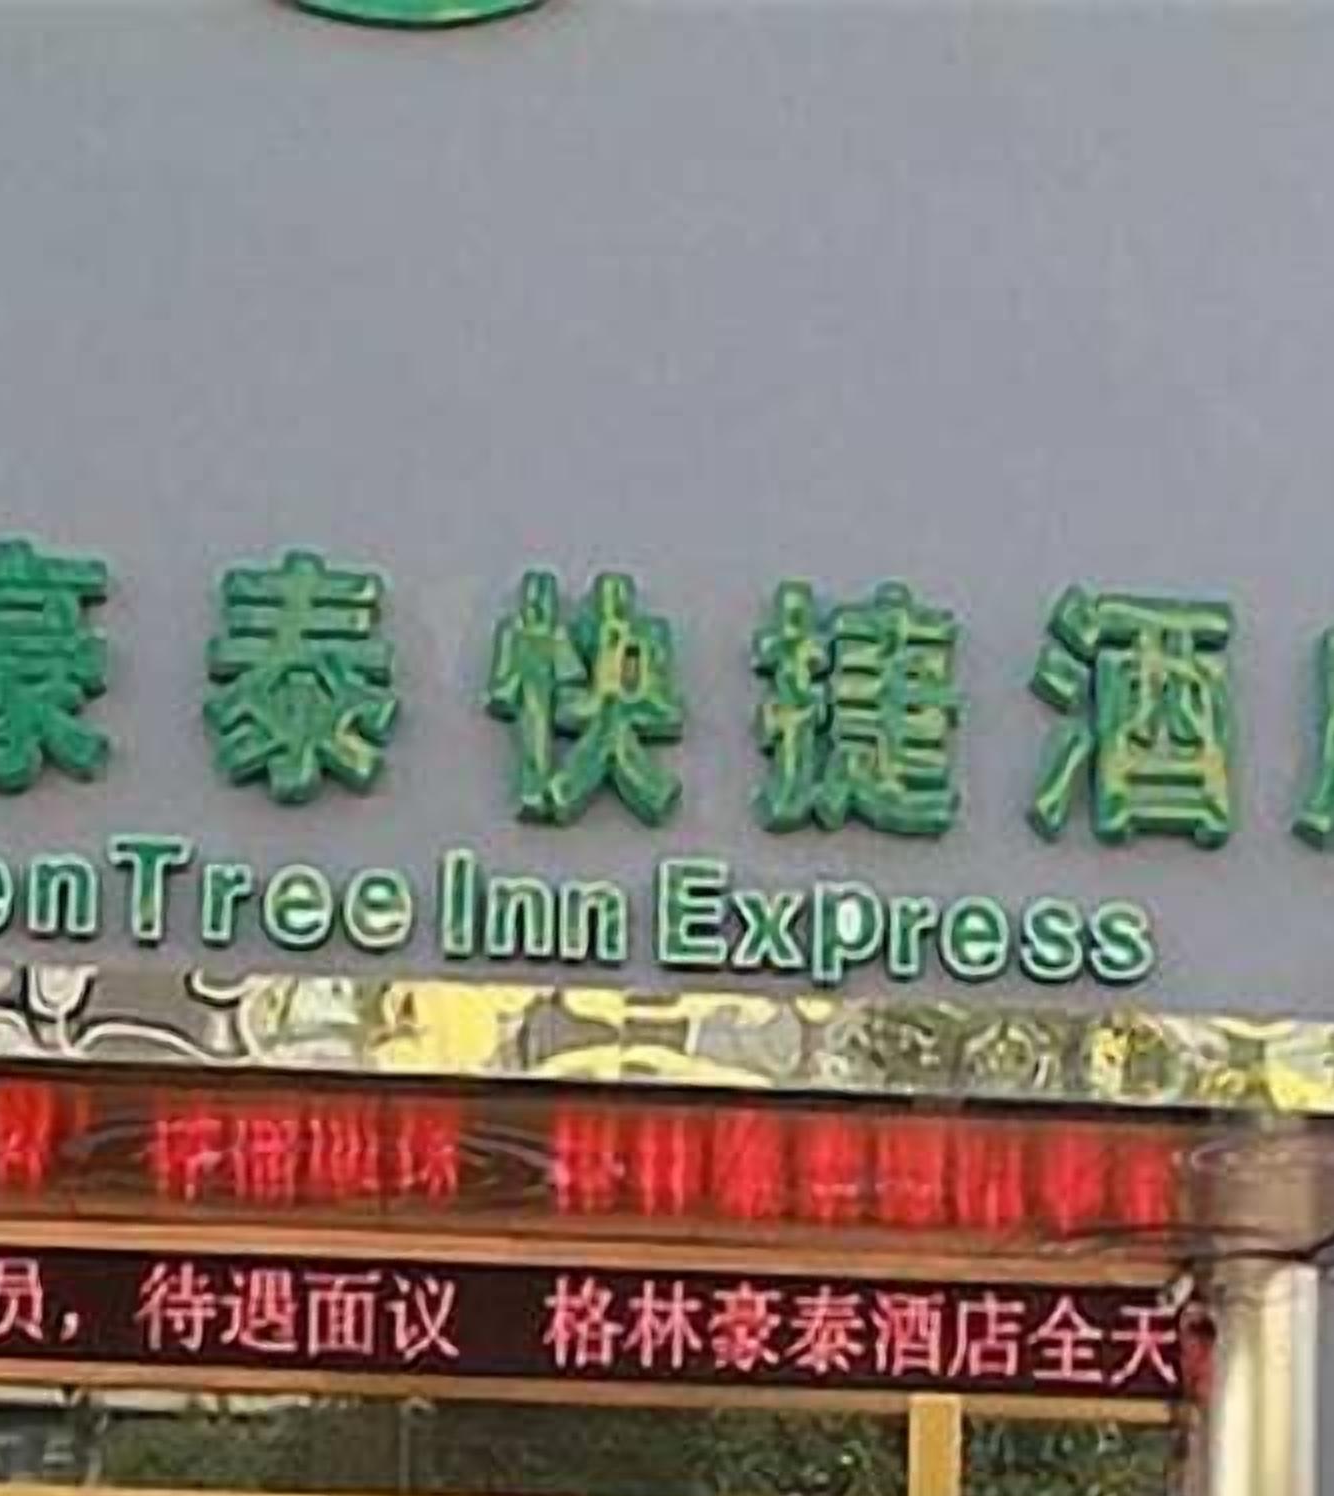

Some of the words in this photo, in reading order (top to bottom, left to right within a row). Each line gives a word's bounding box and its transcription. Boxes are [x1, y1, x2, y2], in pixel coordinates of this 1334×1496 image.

[442, 848, 627, 962] Inn
[657, 857, 1154, 984] Express
[544, 1275, 1177, 1387] 格林豪泰酒店全天
